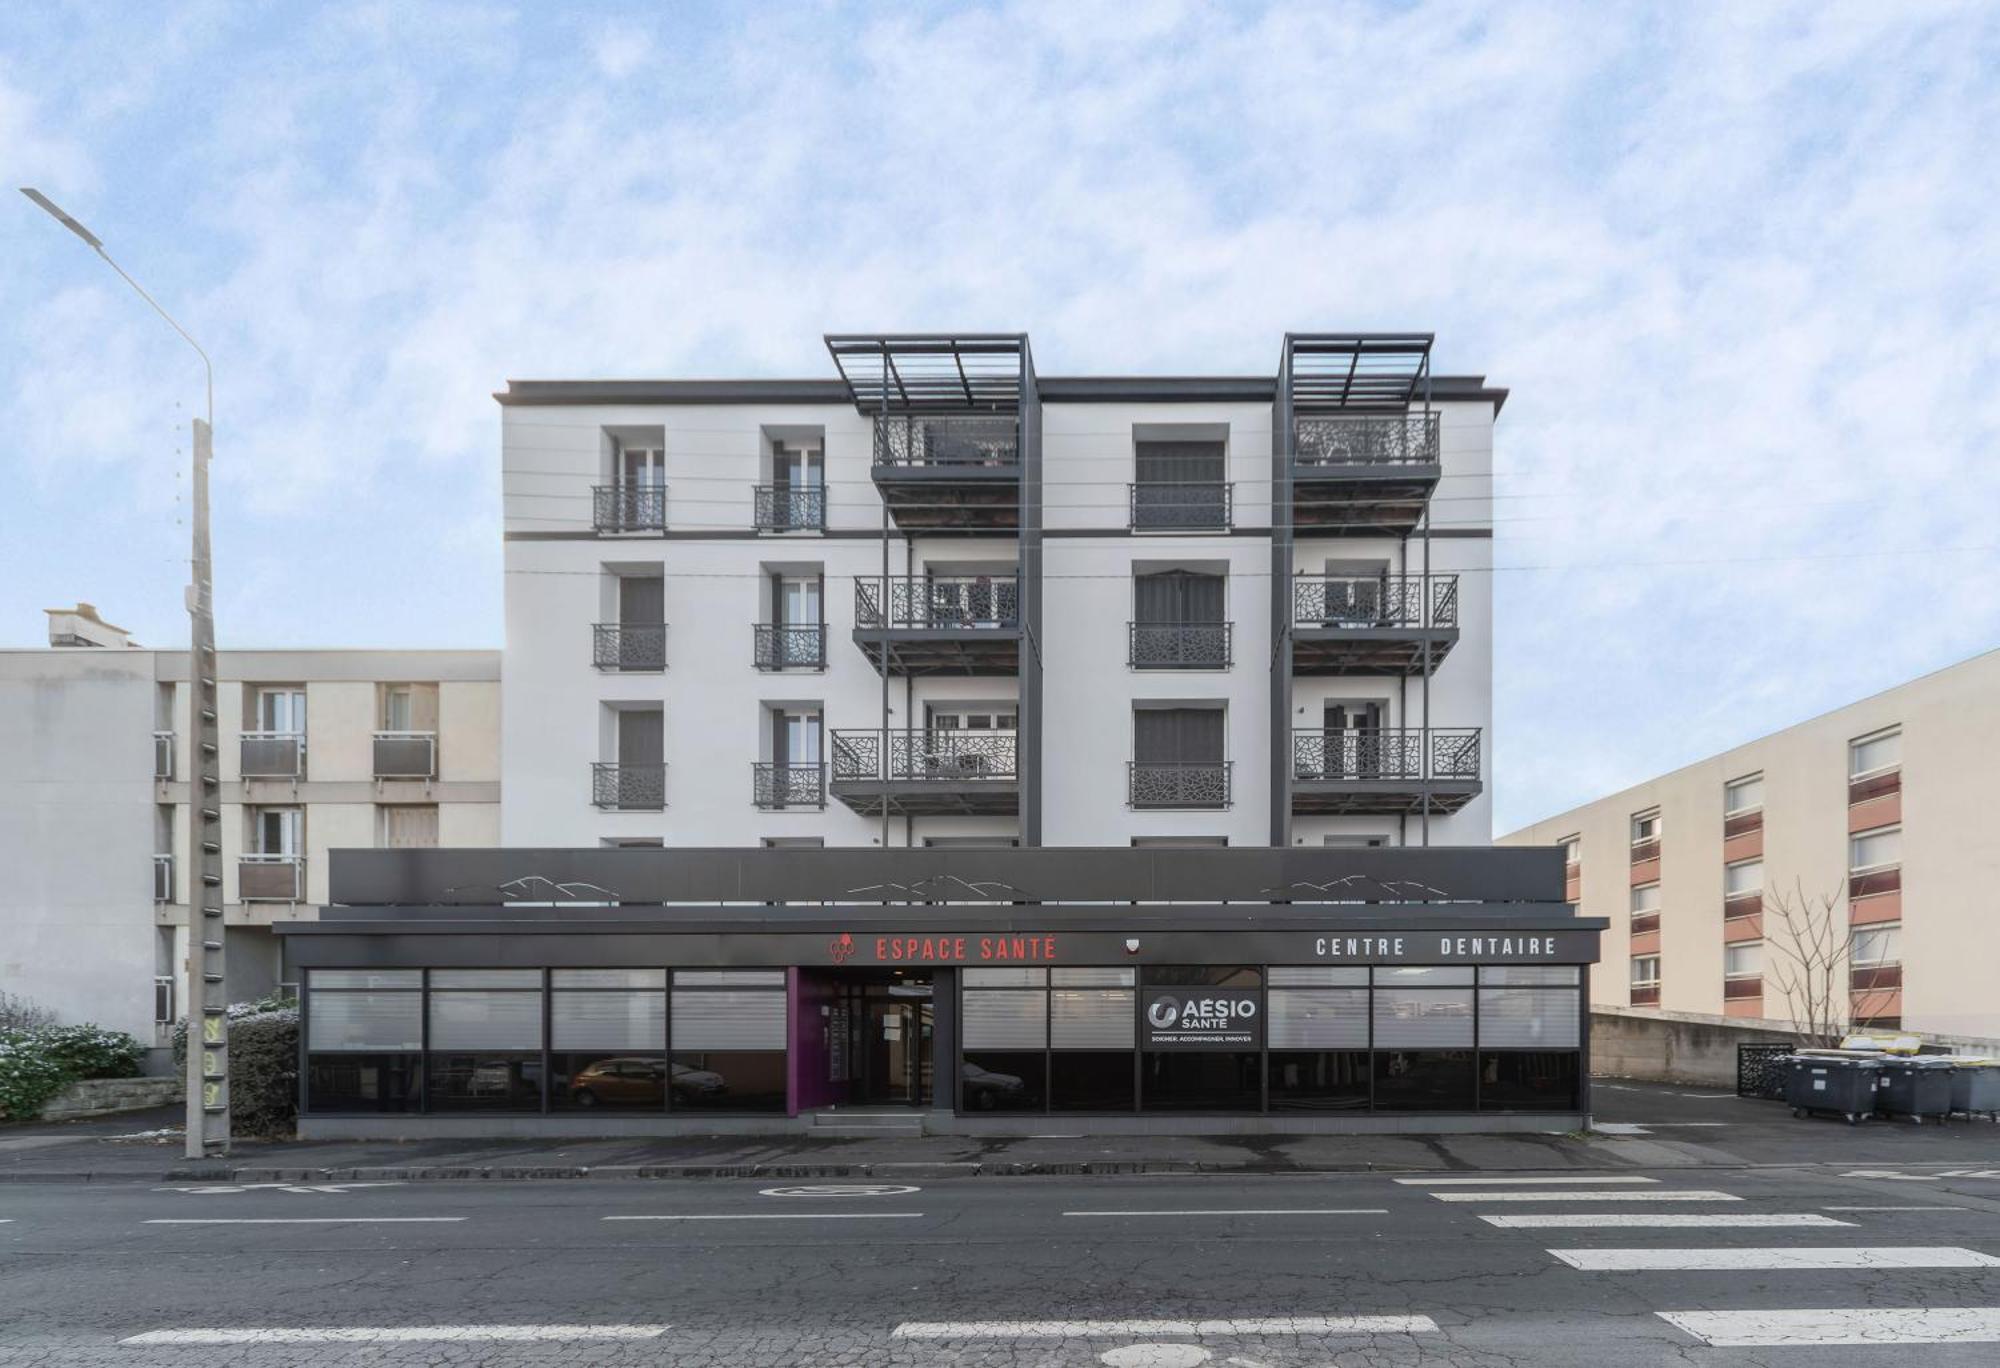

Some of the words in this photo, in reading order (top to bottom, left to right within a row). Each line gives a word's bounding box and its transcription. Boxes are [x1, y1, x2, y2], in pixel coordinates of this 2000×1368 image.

[876, 938, 966, 960] ESPACE
[980, 934, 1057, 960] SANTÉ
[1316, 938, 1404, 956] CENTRE
[1441, 938, 1555, 955] DENTAIRE
[1182, 998, 1256, 1018] AÉSIO
